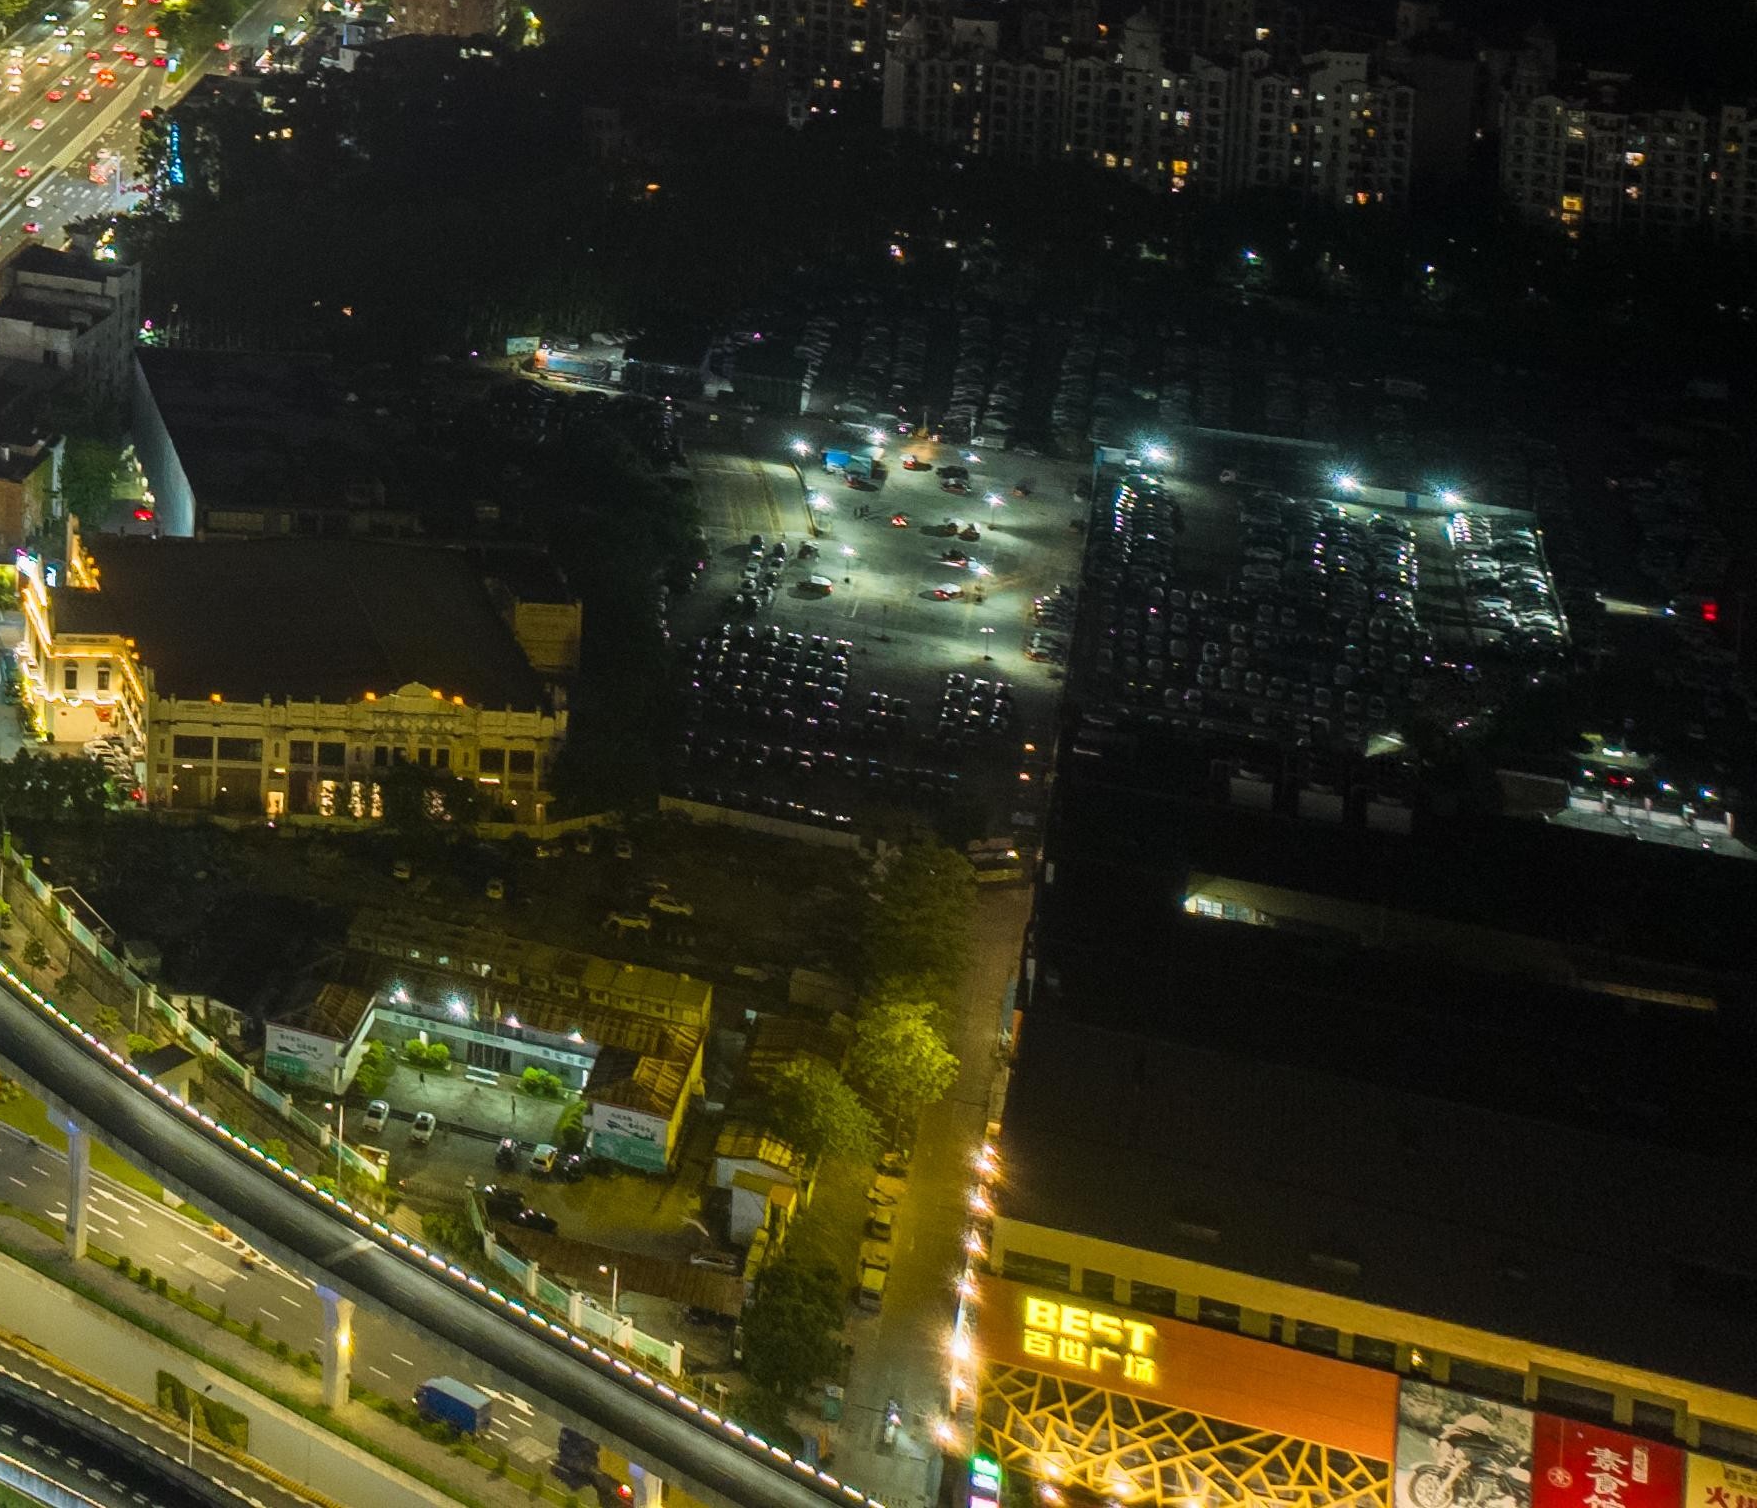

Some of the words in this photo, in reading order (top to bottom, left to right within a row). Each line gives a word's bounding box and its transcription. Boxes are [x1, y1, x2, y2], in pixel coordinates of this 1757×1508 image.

[1025, 1296, 1158, 1354] BEST
[1023, 1328, 1156, 1385] 百世广场
